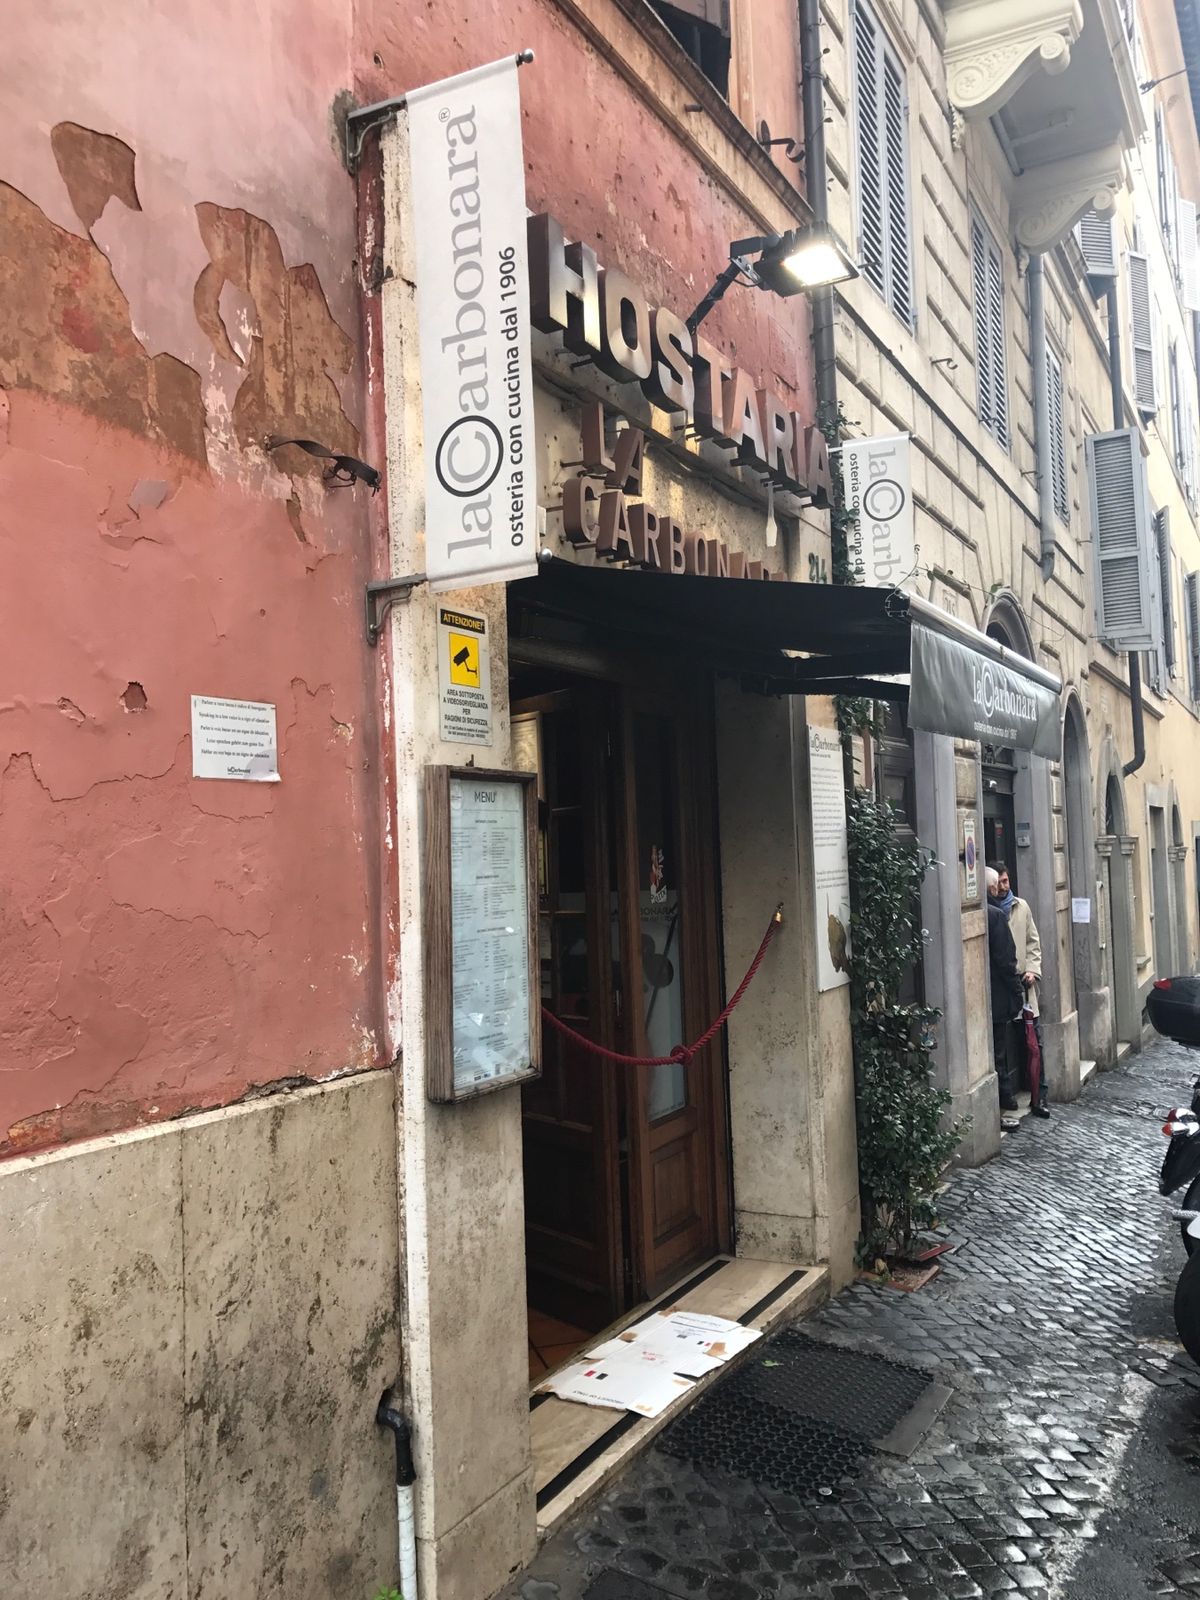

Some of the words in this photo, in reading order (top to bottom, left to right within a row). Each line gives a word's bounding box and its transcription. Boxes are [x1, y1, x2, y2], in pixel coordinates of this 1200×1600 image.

[498, 246, 517, 302] 1906
[500, 306, 518, 341] dal
[502, 346, 521, 419] cucina
[527, 213, 833, 508] HOSTARIA
[510, 424, 524, 466] con
[581, 403, 644, 497] LA
[849, 452, 860, 497] osteria
[506, 469, 524, 547] osteria
[446, 688, 459, 697] AREA
[458, 690, 485, 701] SOTTOPOSTA
[462, 708, 471, 716] PER
[462, 715, 467, 724] DI
